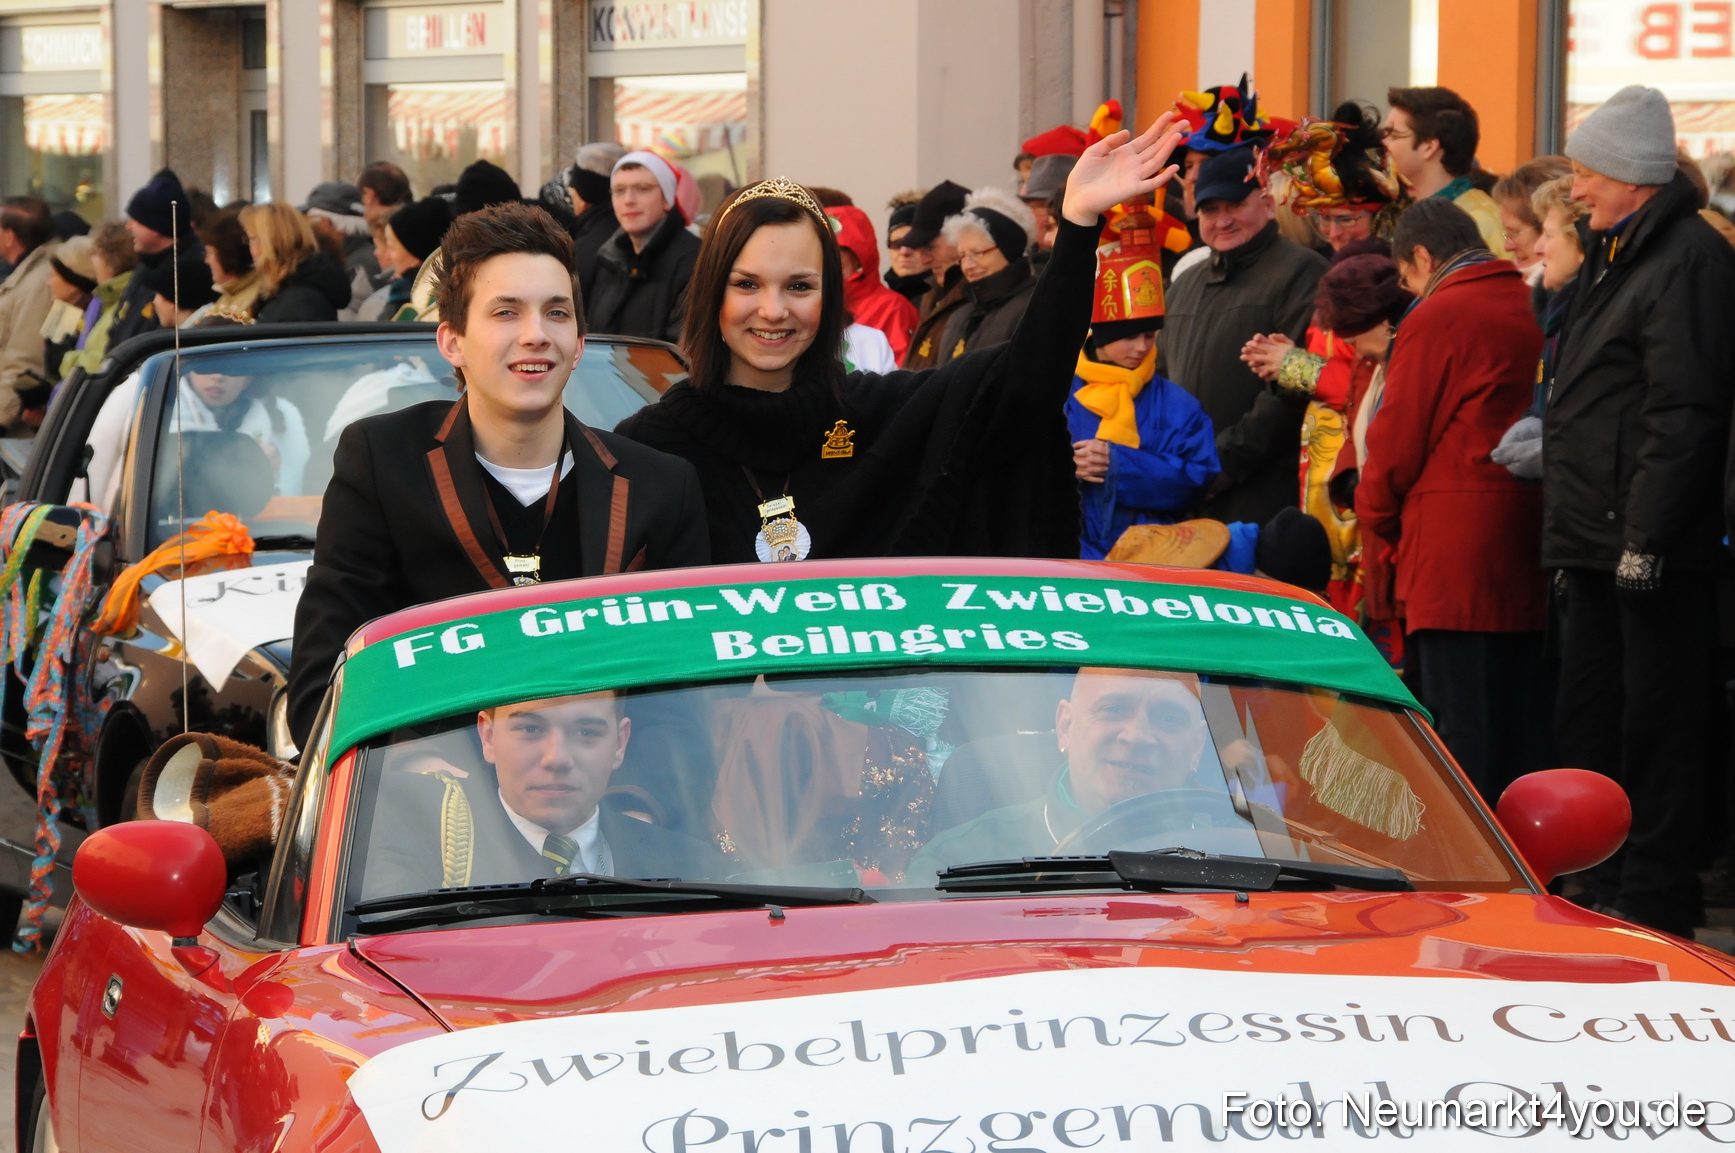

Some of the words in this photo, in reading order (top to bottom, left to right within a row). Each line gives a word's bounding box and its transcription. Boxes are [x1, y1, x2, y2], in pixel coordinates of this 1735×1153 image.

[406, 12, 487, 50] BRILLEN
[394, 623, 485, 668] FG
[519, 583, 907, 637] Grün-Weiß
[943, 584, 1357, 641] Zwiebelonia
[712, 624, 1090, 656] Beilngries
[421, 1003, 1464, 1121] Zwiebelprinzessin
